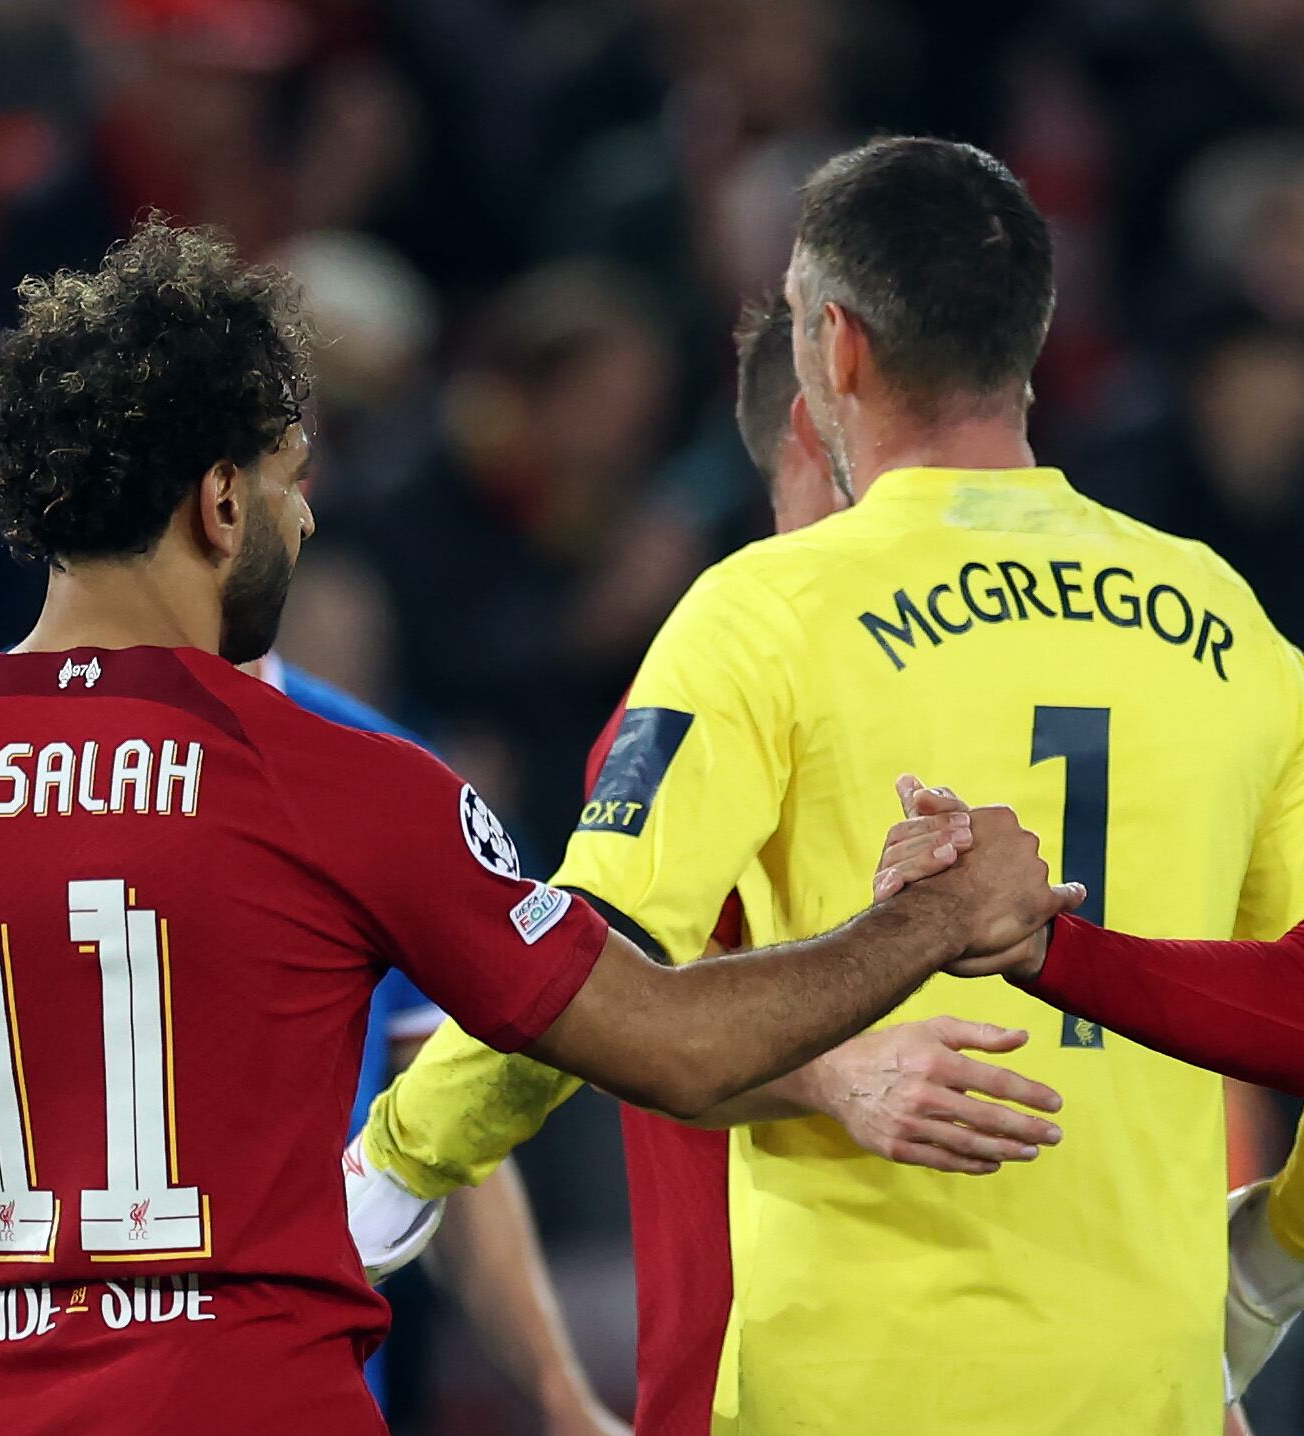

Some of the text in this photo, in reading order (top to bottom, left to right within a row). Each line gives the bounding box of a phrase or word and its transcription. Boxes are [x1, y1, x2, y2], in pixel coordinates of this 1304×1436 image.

[72, 664, 88, 677] 97
[580, 800, 643, 826] OXT
[1029, 705, 1111, 1049] 1
[515, 895, 539, 919] UEFA
[101, 1273, 217, 1330] SIDE
